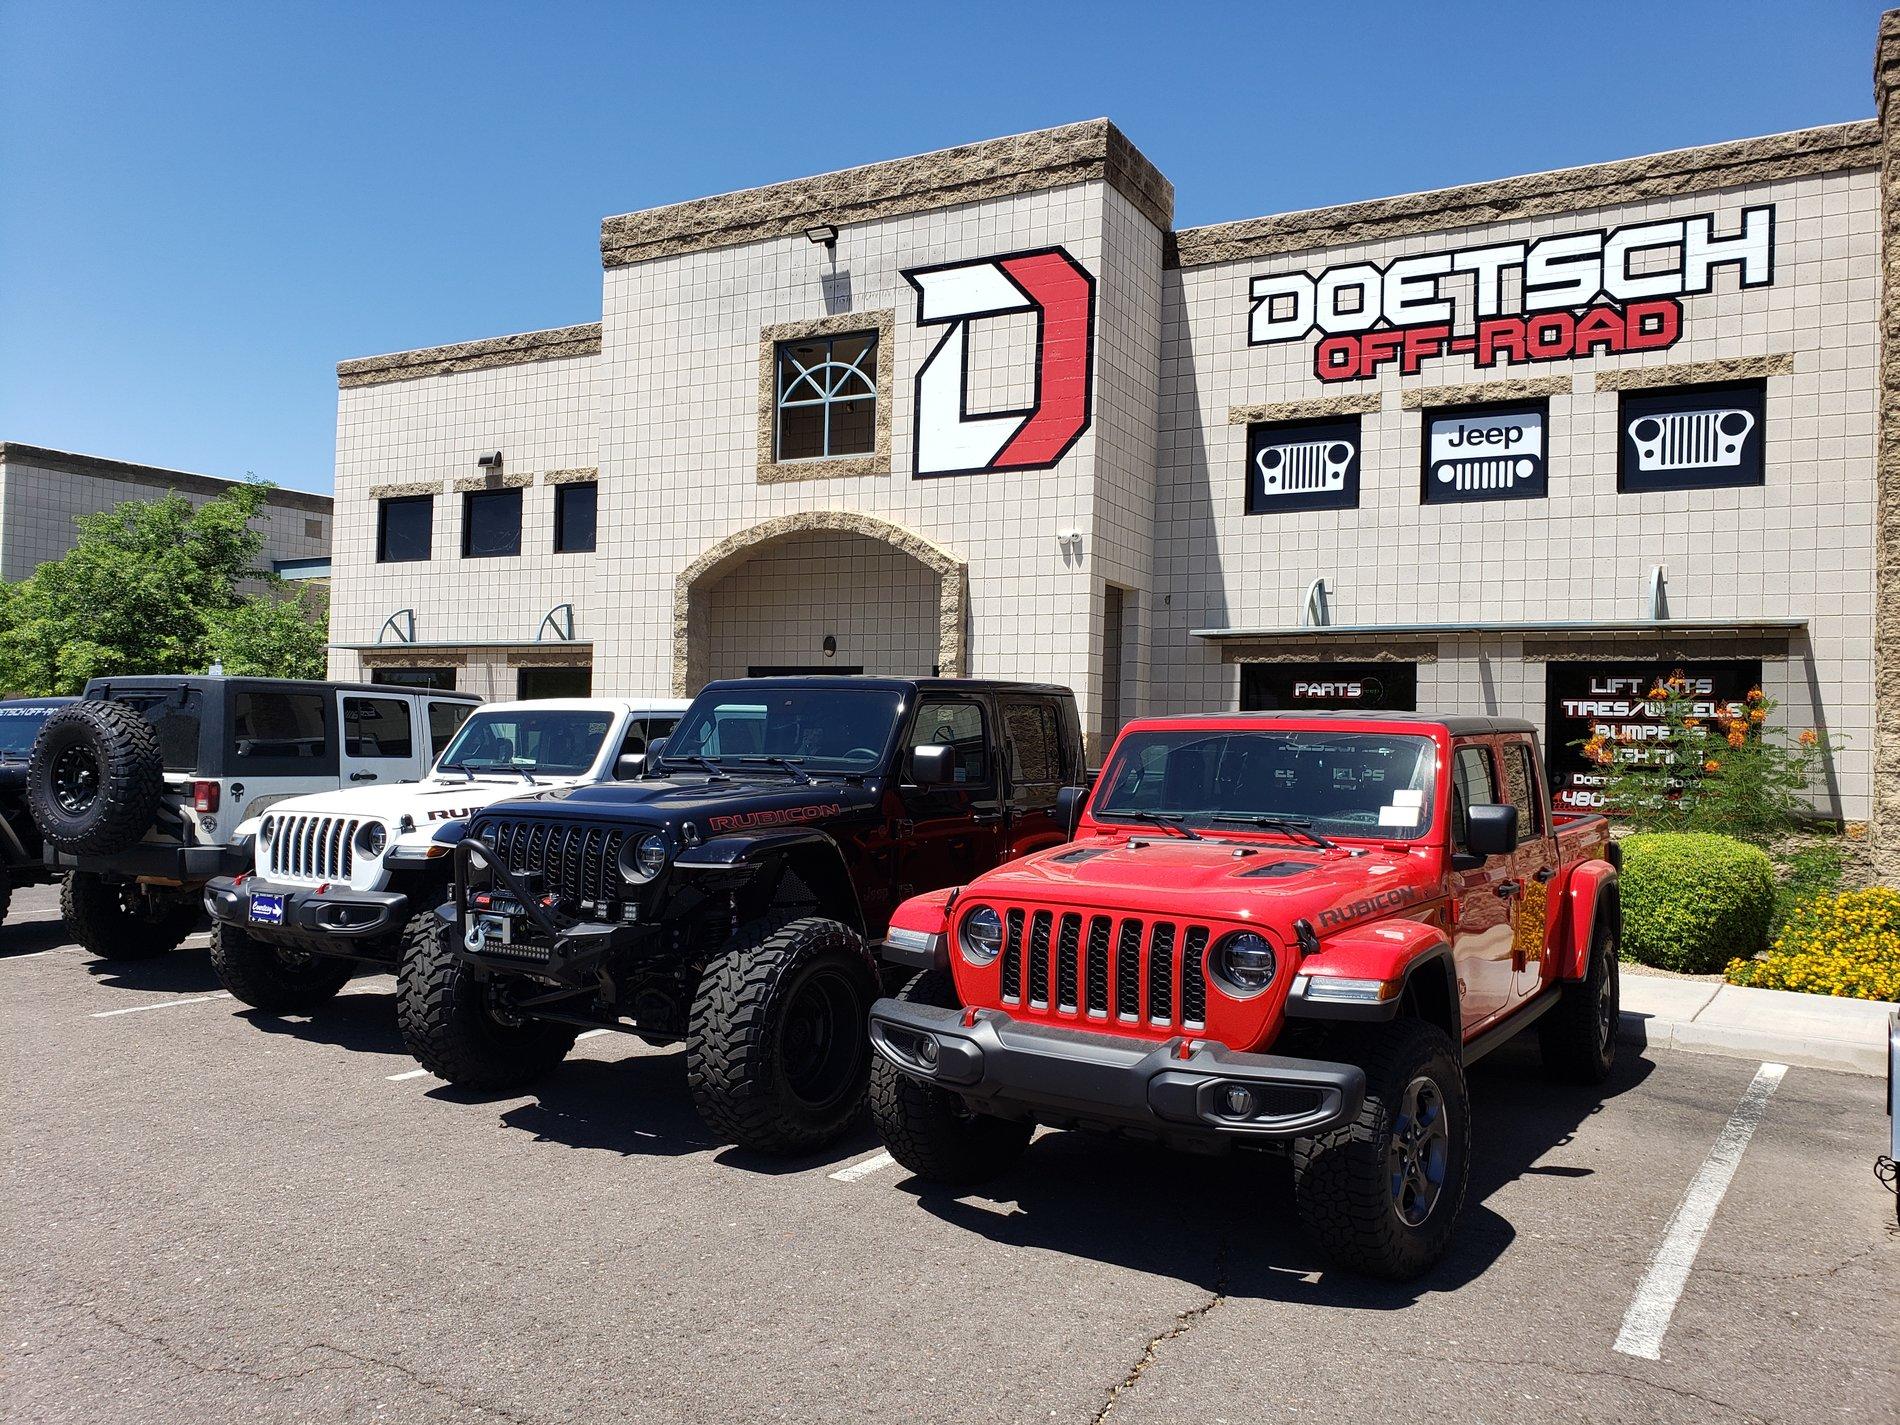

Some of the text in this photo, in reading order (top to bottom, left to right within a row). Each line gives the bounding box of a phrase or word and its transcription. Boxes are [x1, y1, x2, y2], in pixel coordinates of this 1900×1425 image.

[1248, 203, 1776, 347] DOETSCH
[1313, 299, 1684, 384] OFF-ROAD
[1448, 424, 1523, 449] Jeep
[1294, 682, 1362, 697] PARTS
[1591, 678, 1643, 693] LIFT
[709, 803, 841, 831] RUBICON
[1318, 885, 1416, 928] RUBICON
